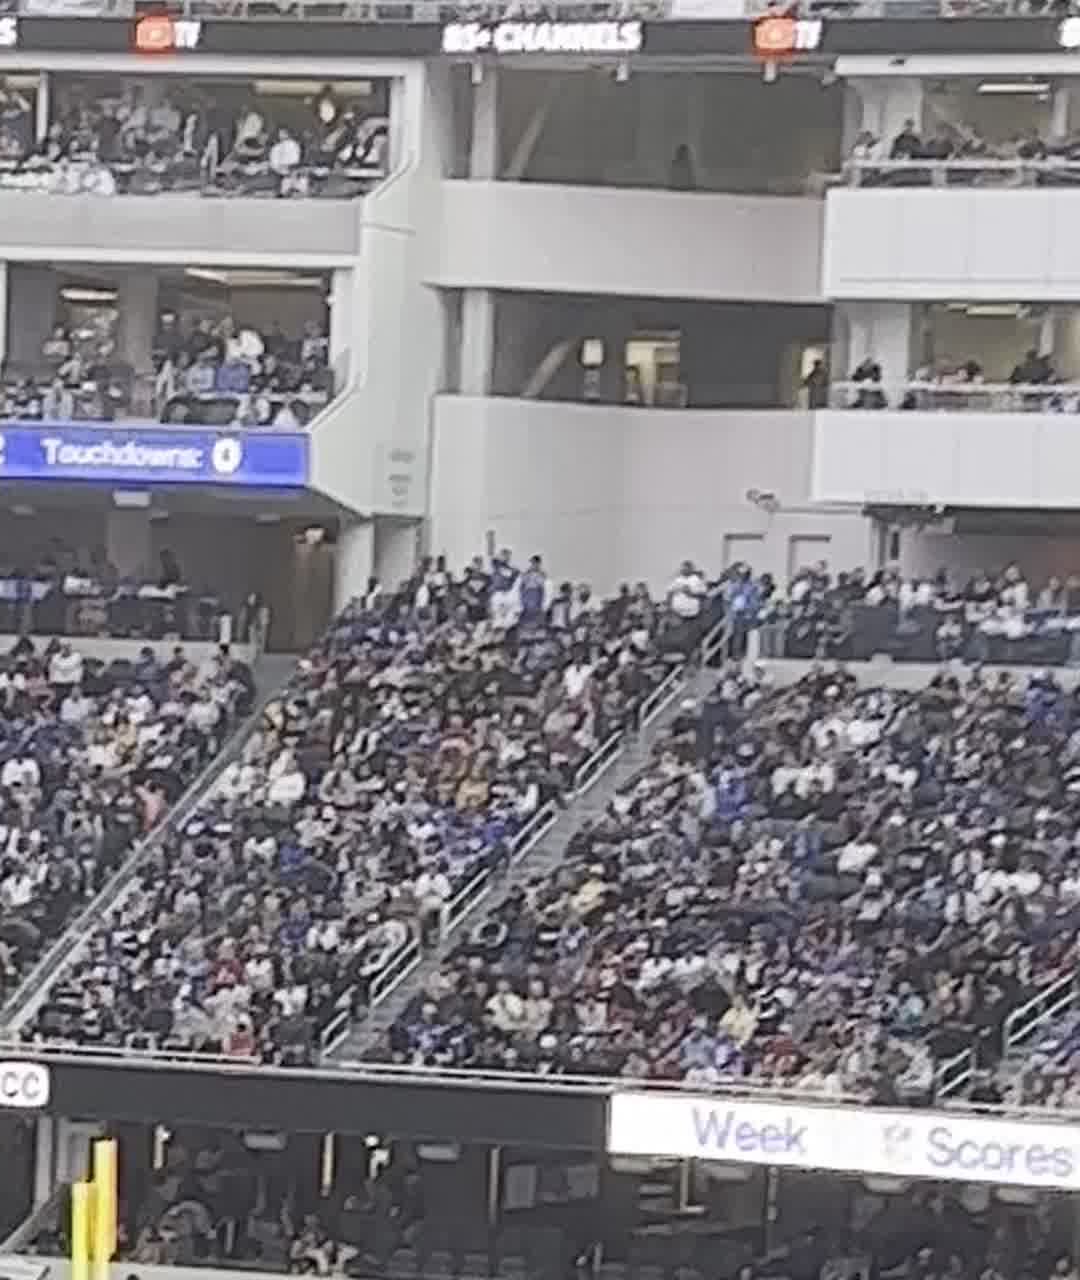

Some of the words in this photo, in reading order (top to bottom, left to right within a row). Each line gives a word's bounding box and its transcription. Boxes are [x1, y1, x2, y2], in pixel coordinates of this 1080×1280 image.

[494, 21, 642, 52] CHANNELS
[211, 437, 243, 474] 0
[1, 1072, 41, 1101] CC
[691, 1106, 808, 1155] Week
[926, 1126, 1073, 1178] Scores
